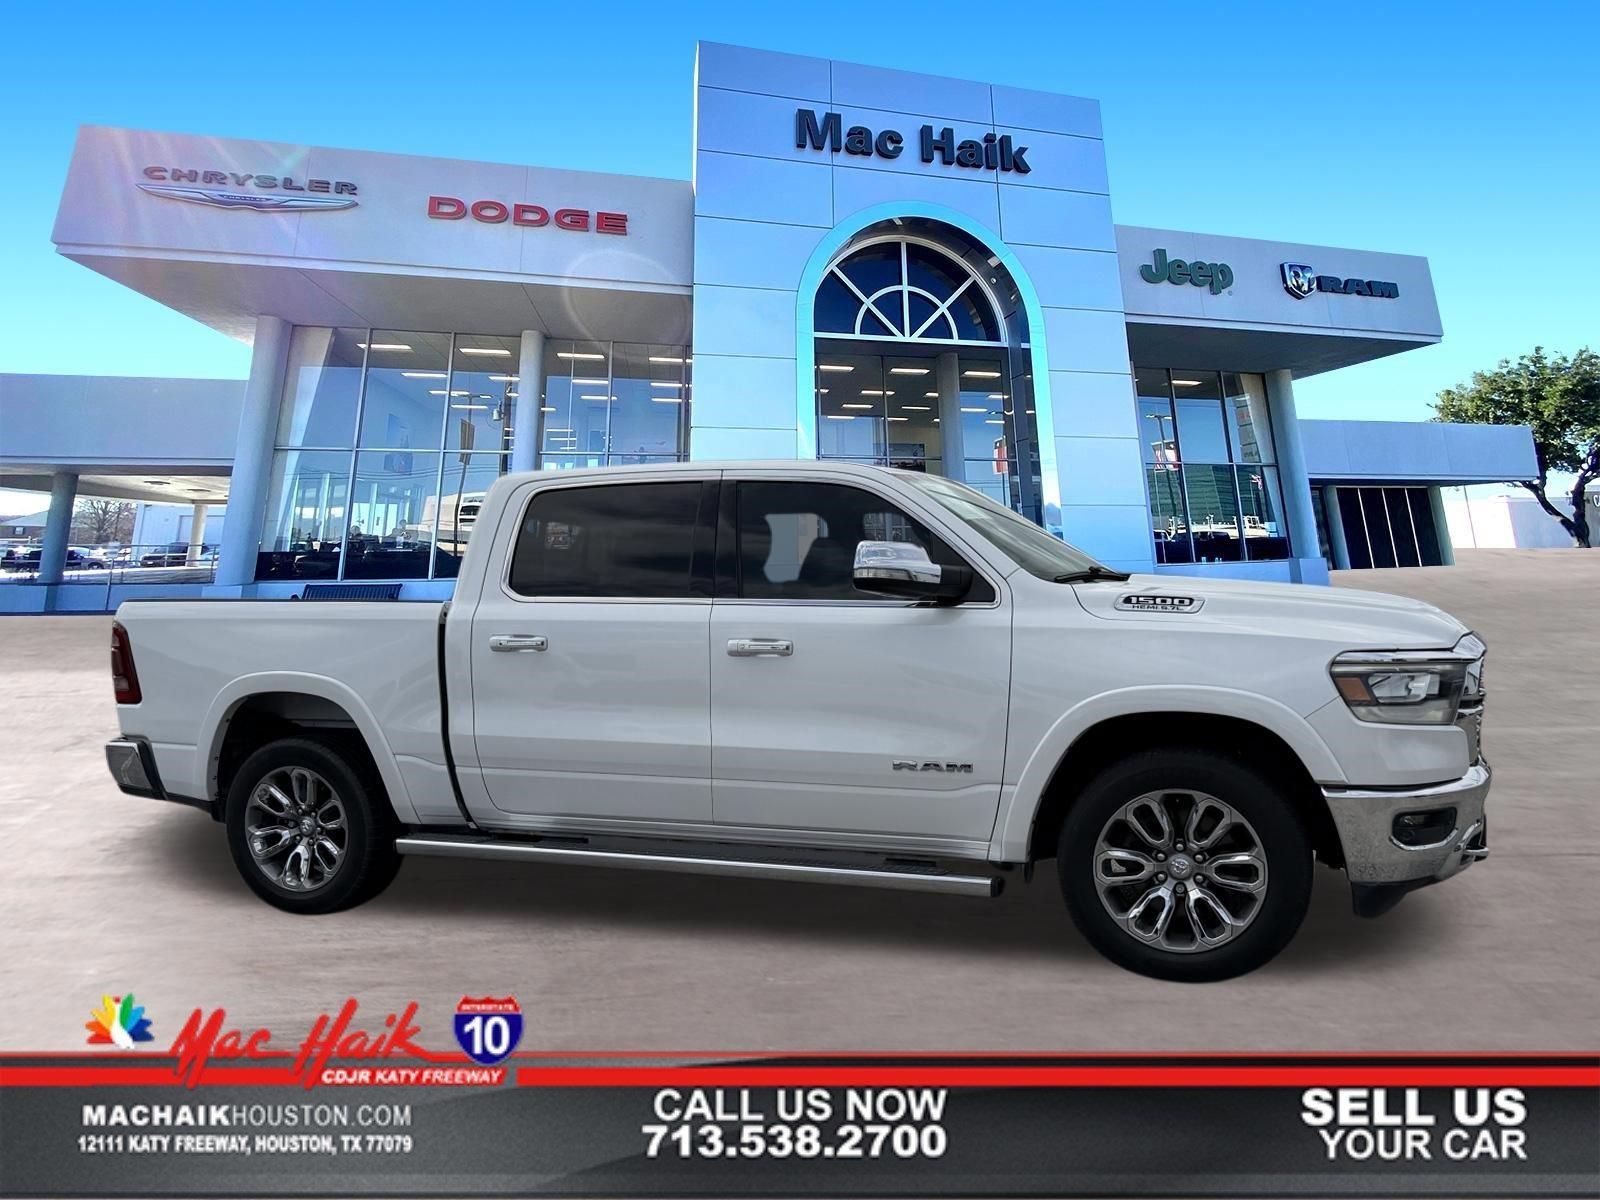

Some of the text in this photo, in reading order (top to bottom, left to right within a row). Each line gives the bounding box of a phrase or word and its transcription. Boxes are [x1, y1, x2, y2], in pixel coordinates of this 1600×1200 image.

[796, 108, 1032, 174] Mac Haik
[143, 166, 358, 195] CHRYSLER
[428, 196, 628, 236] DODGE
[1139, 248, 1234, 295] Jeep
[1315, 275, 1400, 299] RAM
[1130, 596, 1190, 606] 1500
[892, 760, 973, 773] RAM
